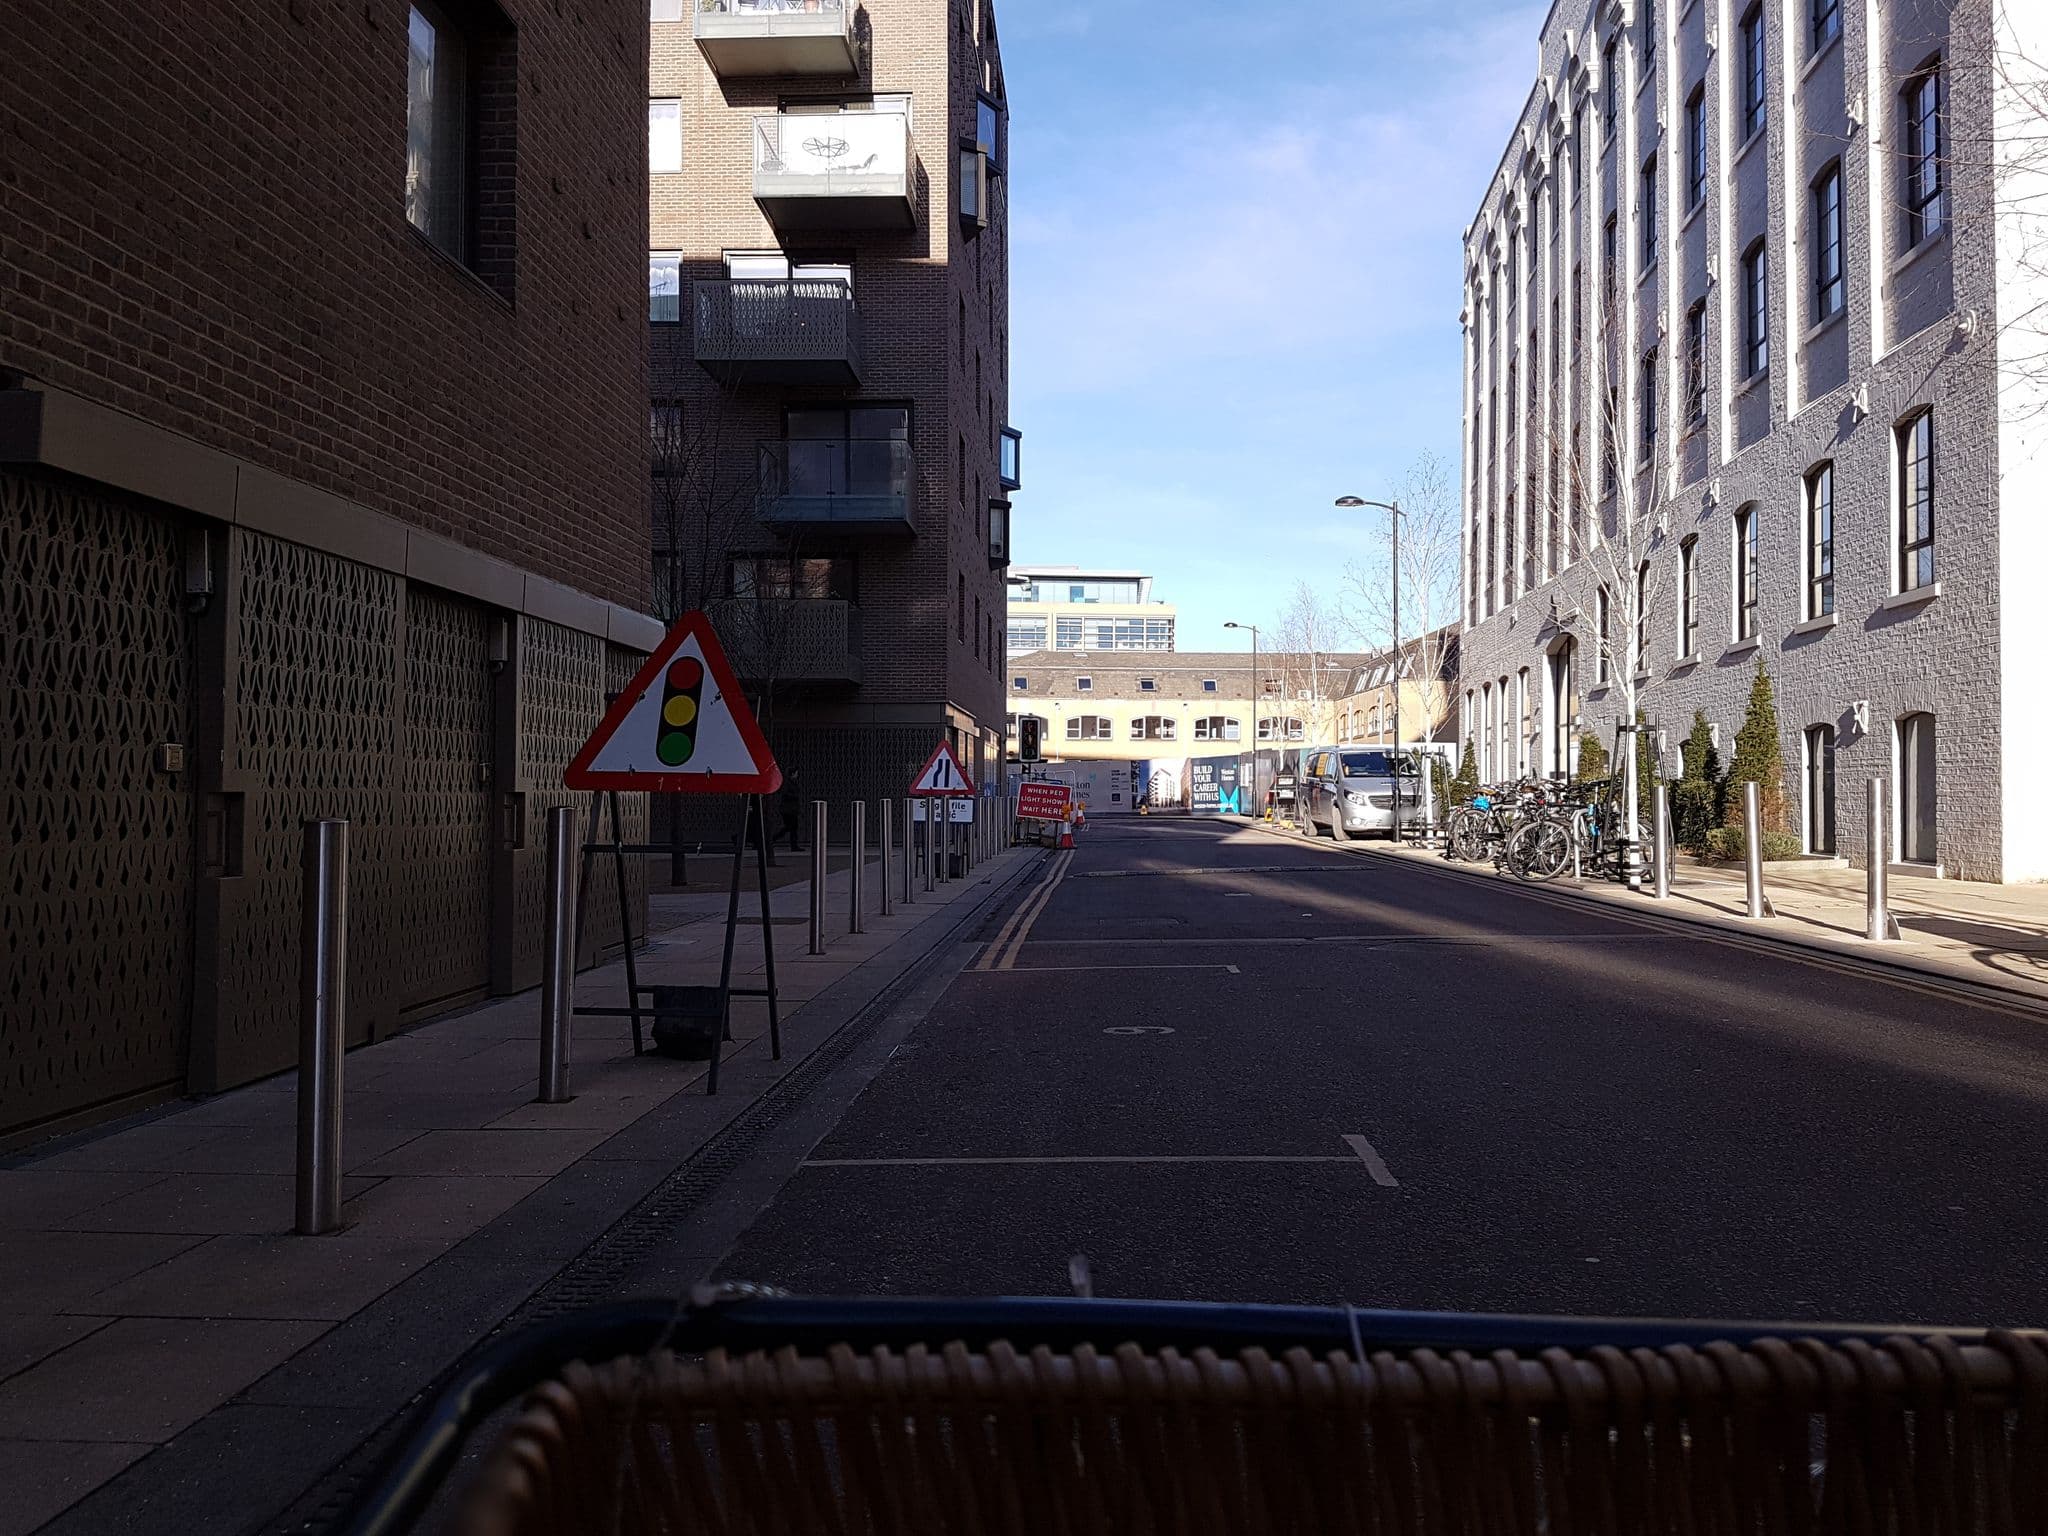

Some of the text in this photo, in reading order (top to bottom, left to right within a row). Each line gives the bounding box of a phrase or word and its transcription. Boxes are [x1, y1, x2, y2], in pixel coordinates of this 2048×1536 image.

[1193, 765, 1212, 774] BUILD
[1193, 775, 1211, 783] YOUR
[1027, 787, 1048, 795] WHEN
[1193, 783, 1218, 792] CAREER
[1021, 795, 1041, 803] LIGHT
[1193, 792, 1219, 800] WITH US
[951, 801, 966, 810] file
[1022, 805, 1064, 816] WAIT HERE
